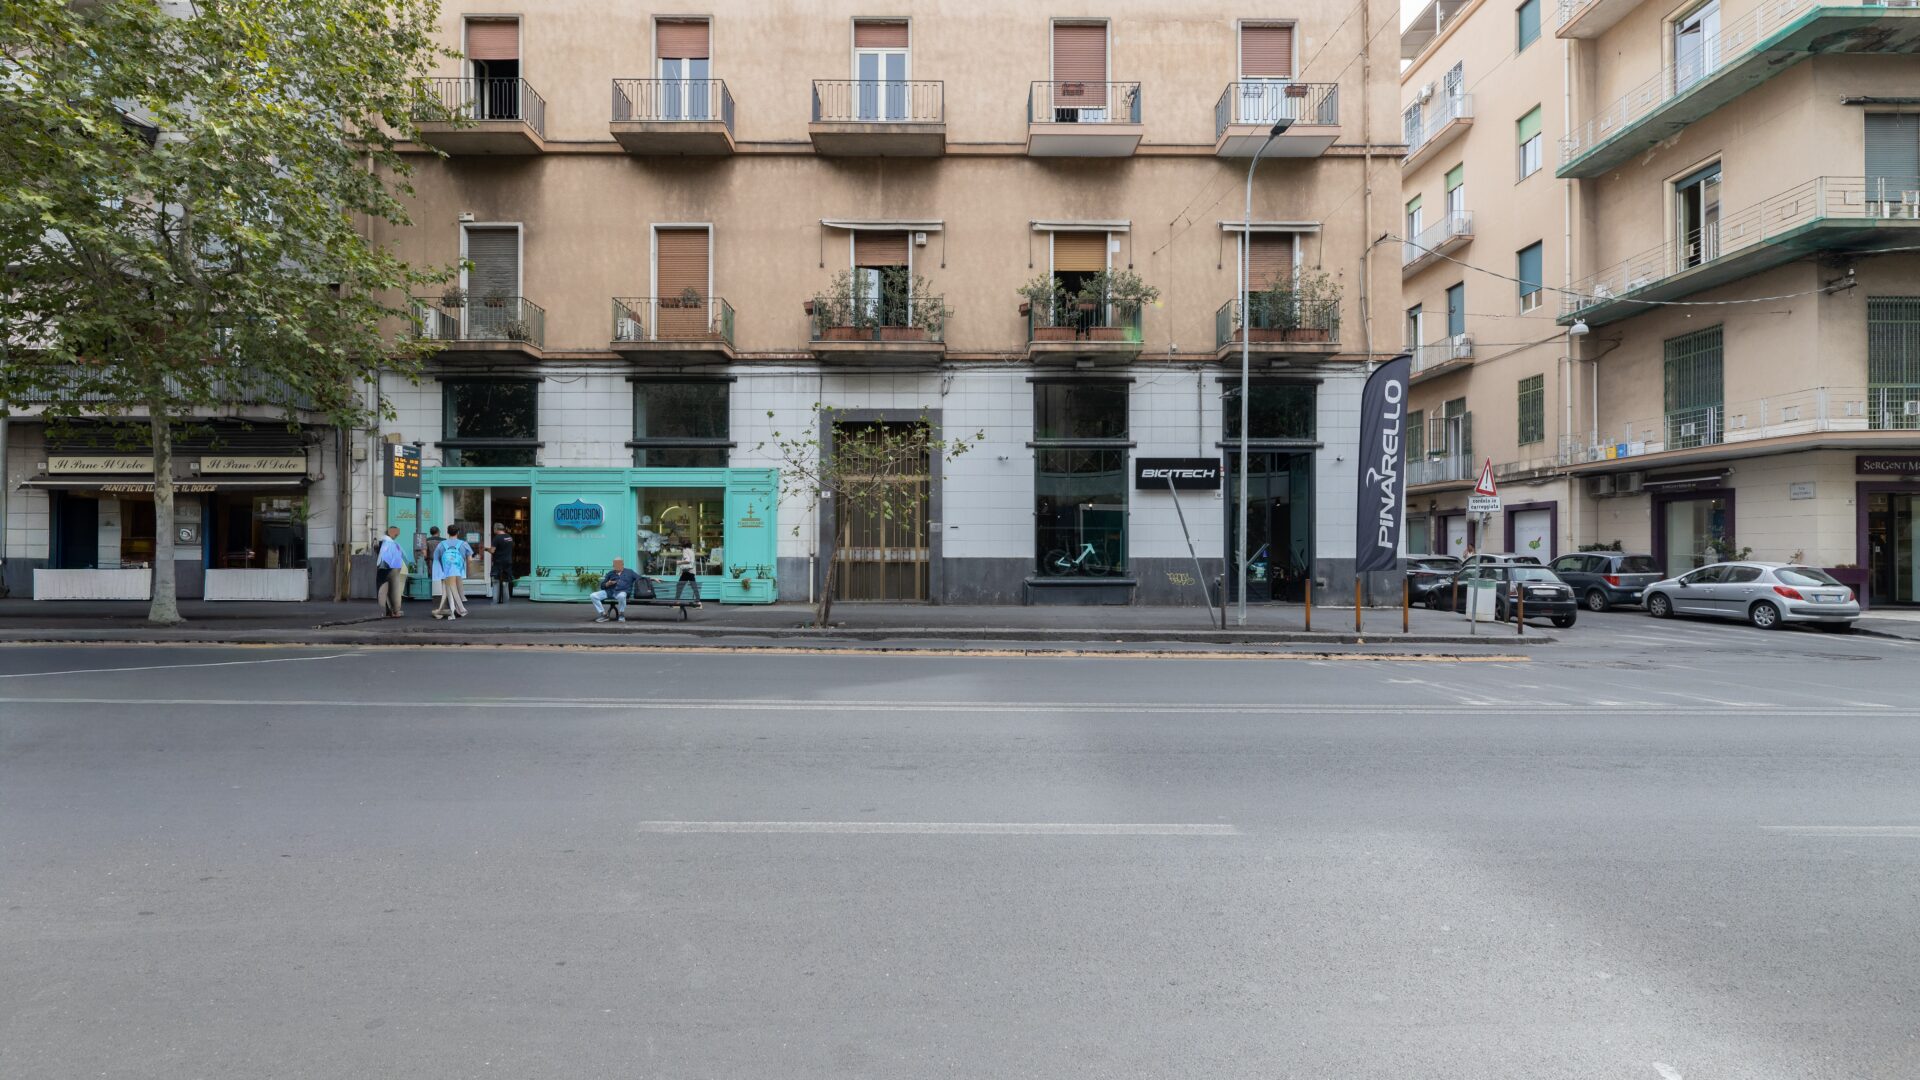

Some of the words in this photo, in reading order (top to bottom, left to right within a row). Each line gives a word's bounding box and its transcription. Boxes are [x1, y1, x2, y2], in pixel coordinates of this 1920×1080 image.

[54, 459, 69, 469] Il
[70, 459, 99, 469] Pane
[100, 459, 115, 469] Il
[116, 459, 146, 469] Dolce
[207, 459, 222, 469] Il
[223, 459, 252, 469] Pane
[253, 459, 267, 469] Il
[268, 459, 299, 469] Dolce
[100, 484, 144, 492] PANIFICIO
[145, 484, 155, 492] IL
[556, 508, 601, 521] CHOCOFUSION
